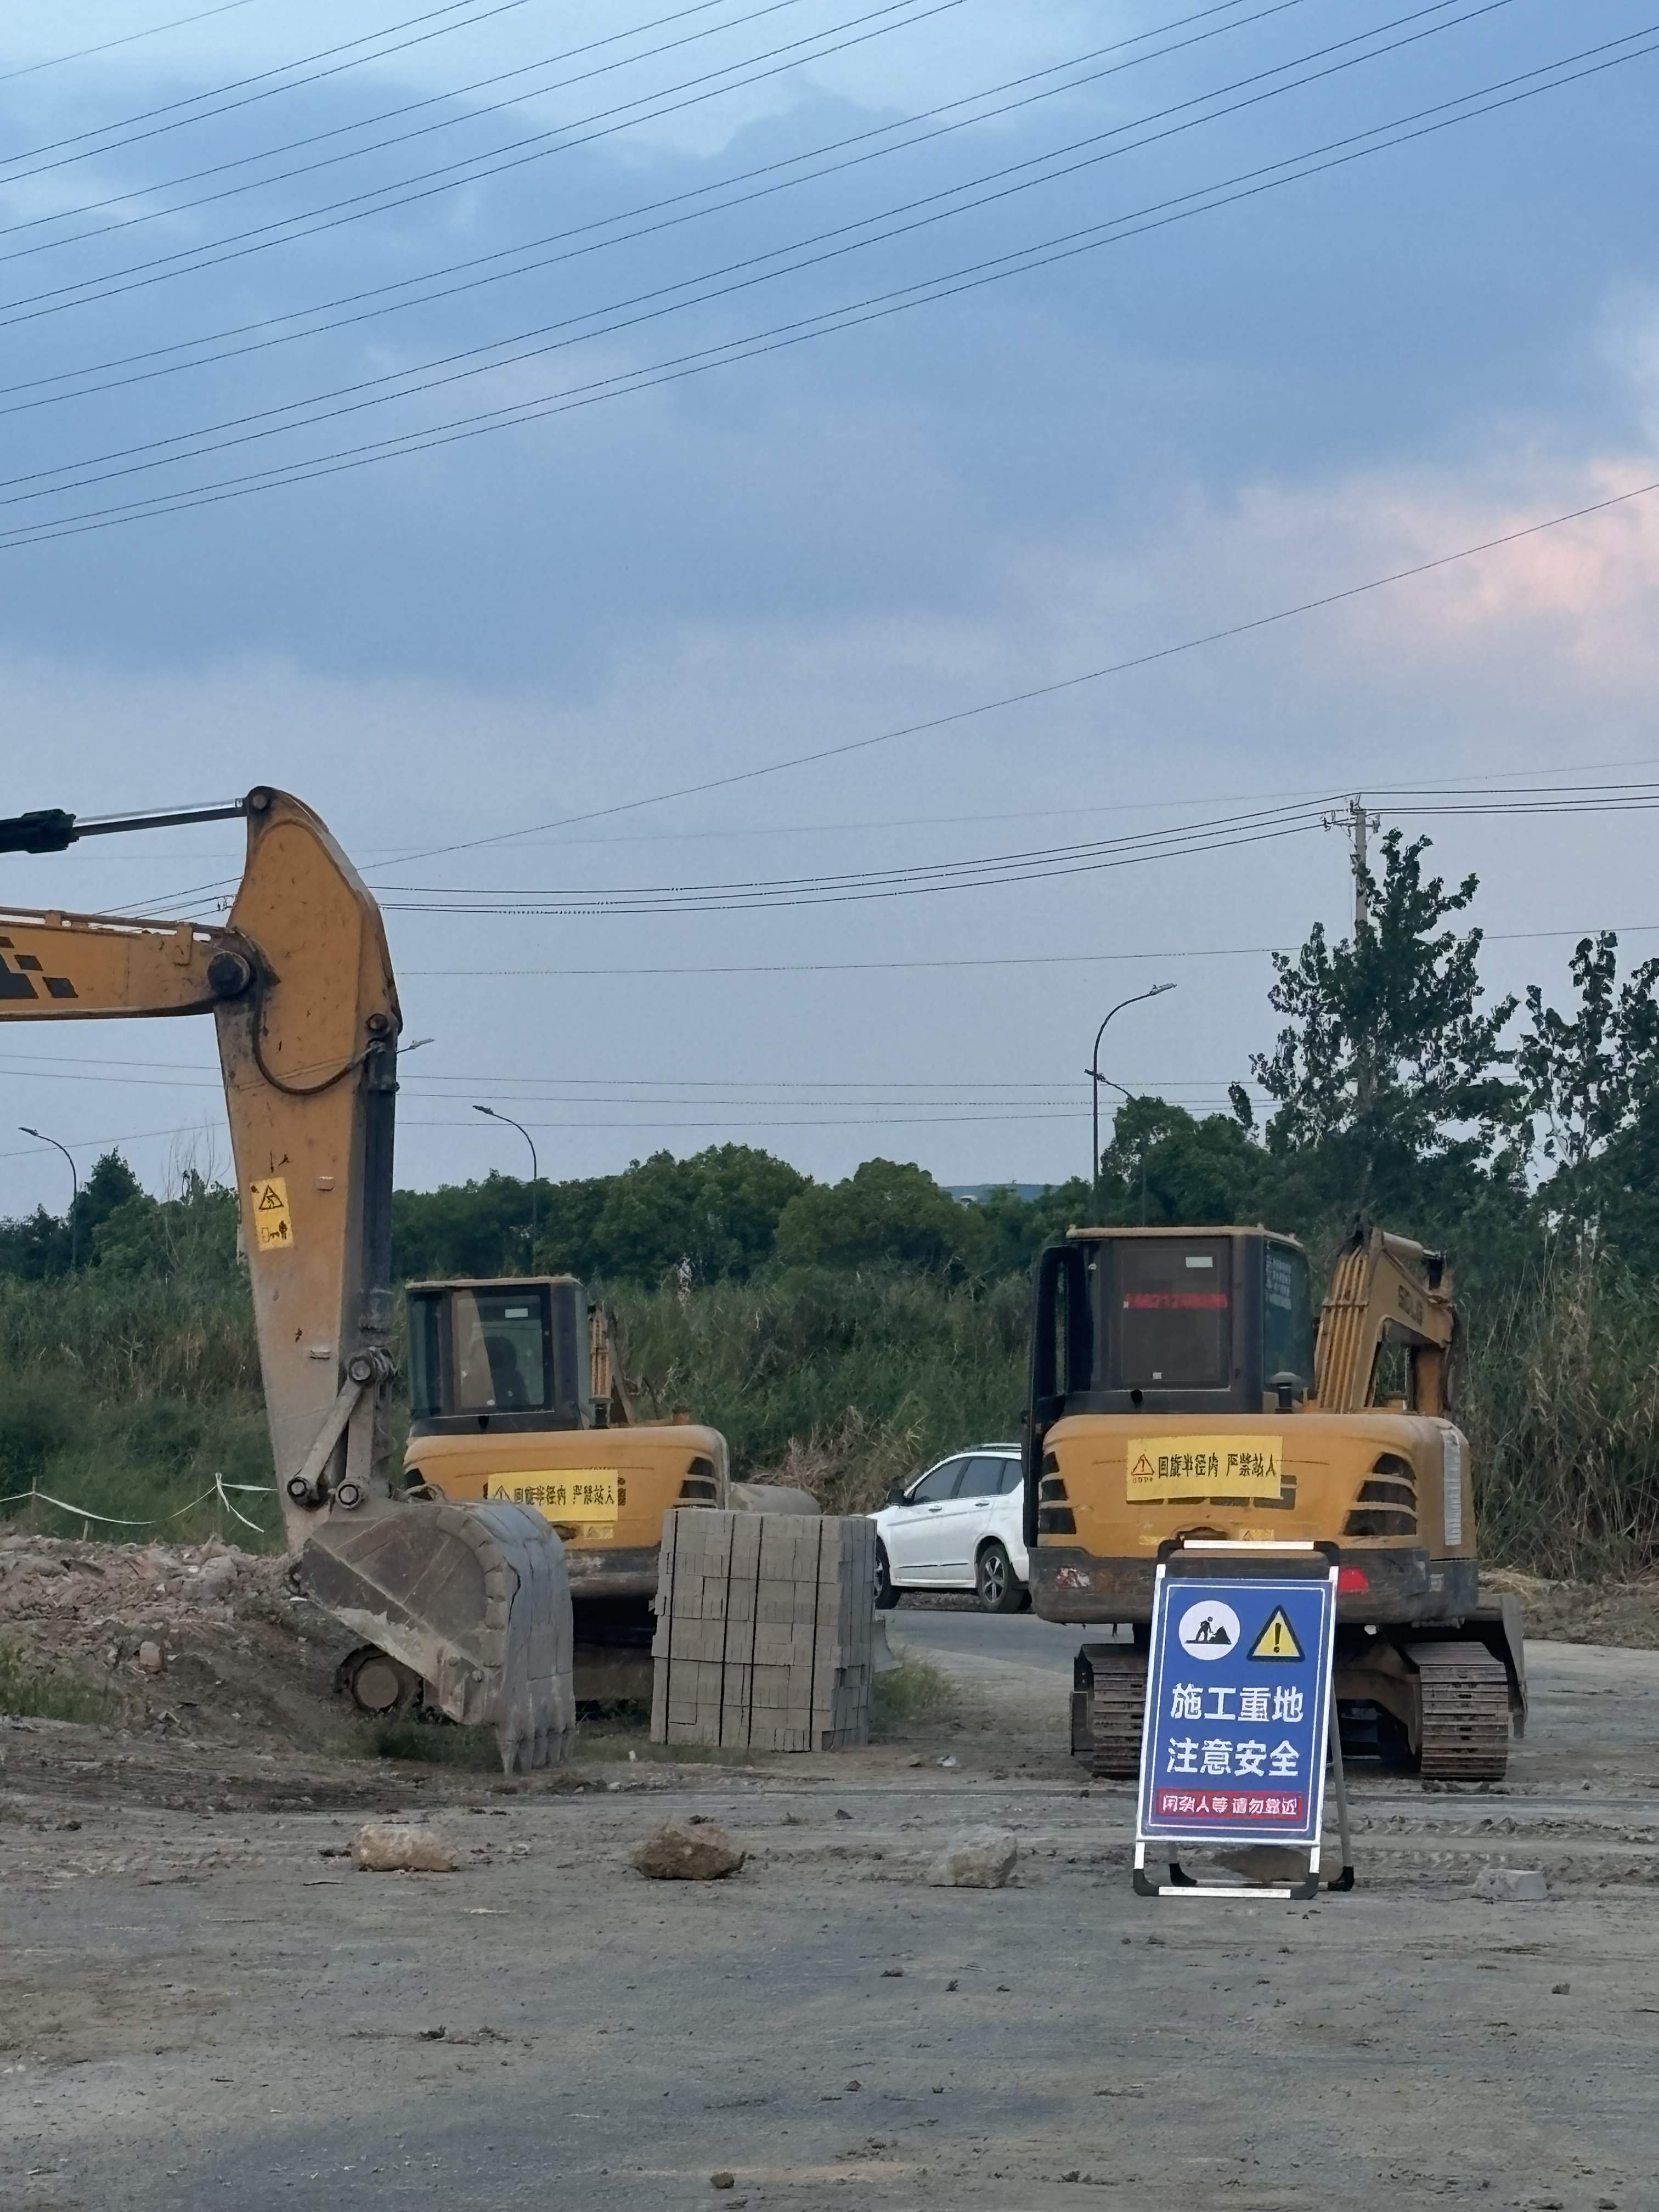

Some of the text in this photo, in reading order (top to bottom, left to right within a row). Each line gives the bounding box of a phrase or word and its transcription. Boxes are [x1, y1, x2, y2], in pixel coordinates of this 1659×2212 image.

[1159, 1452, 1218, 1479] 回旋半径内
[1170, 1683, 1304, 1723] 施工重地
[1166, 1737, 1300, 1777] 注意安全
[1163, 1795, 1297, 1815] 闲杂人等 请勿靠近
